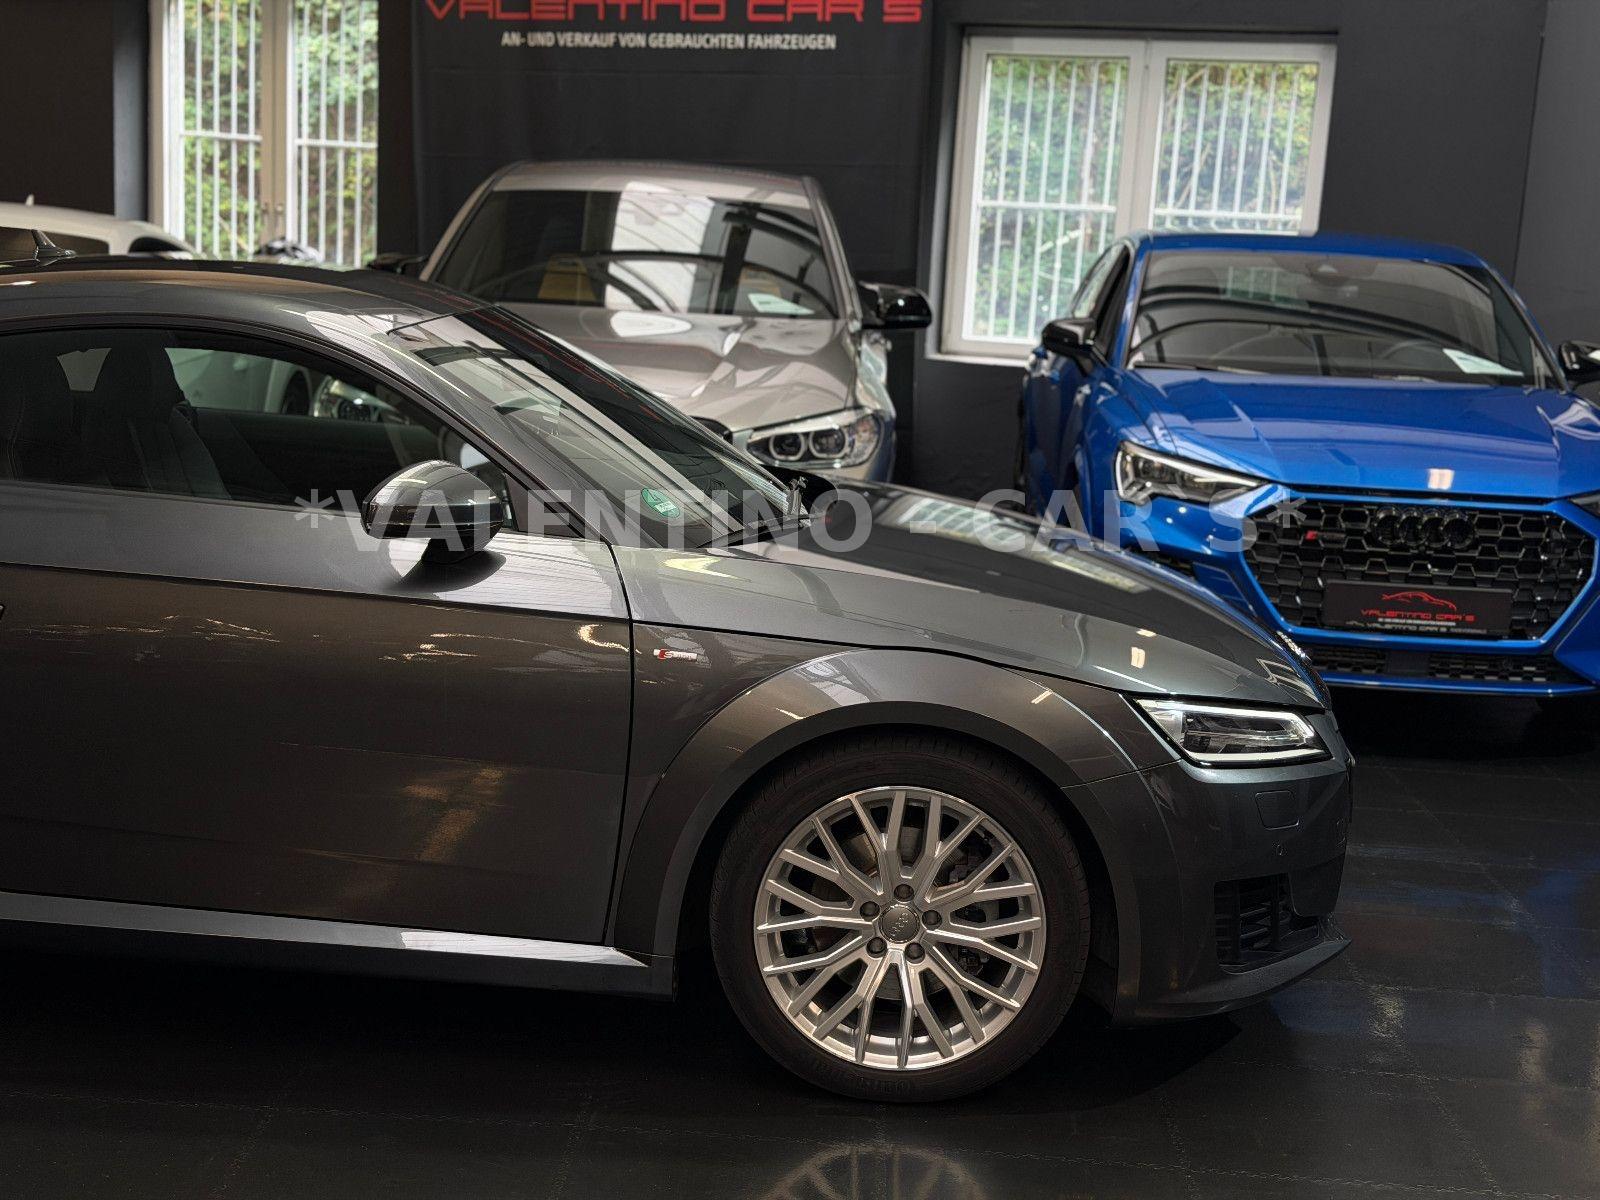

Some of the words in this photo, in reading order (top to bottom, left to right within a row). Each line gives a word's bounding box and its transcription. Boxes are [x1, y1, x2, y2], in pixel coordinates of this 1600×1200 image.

[501, 31, 526, 47] AN-
[527, 32, 555, 47] UND
[557, 32, 616, 48] VERKAUF
[617, 33, 647, 48] VON
[648, 33, 744, 49] GEBRAUCHTEN
[747, 34, 837, 49] FAHRZEUGEN
